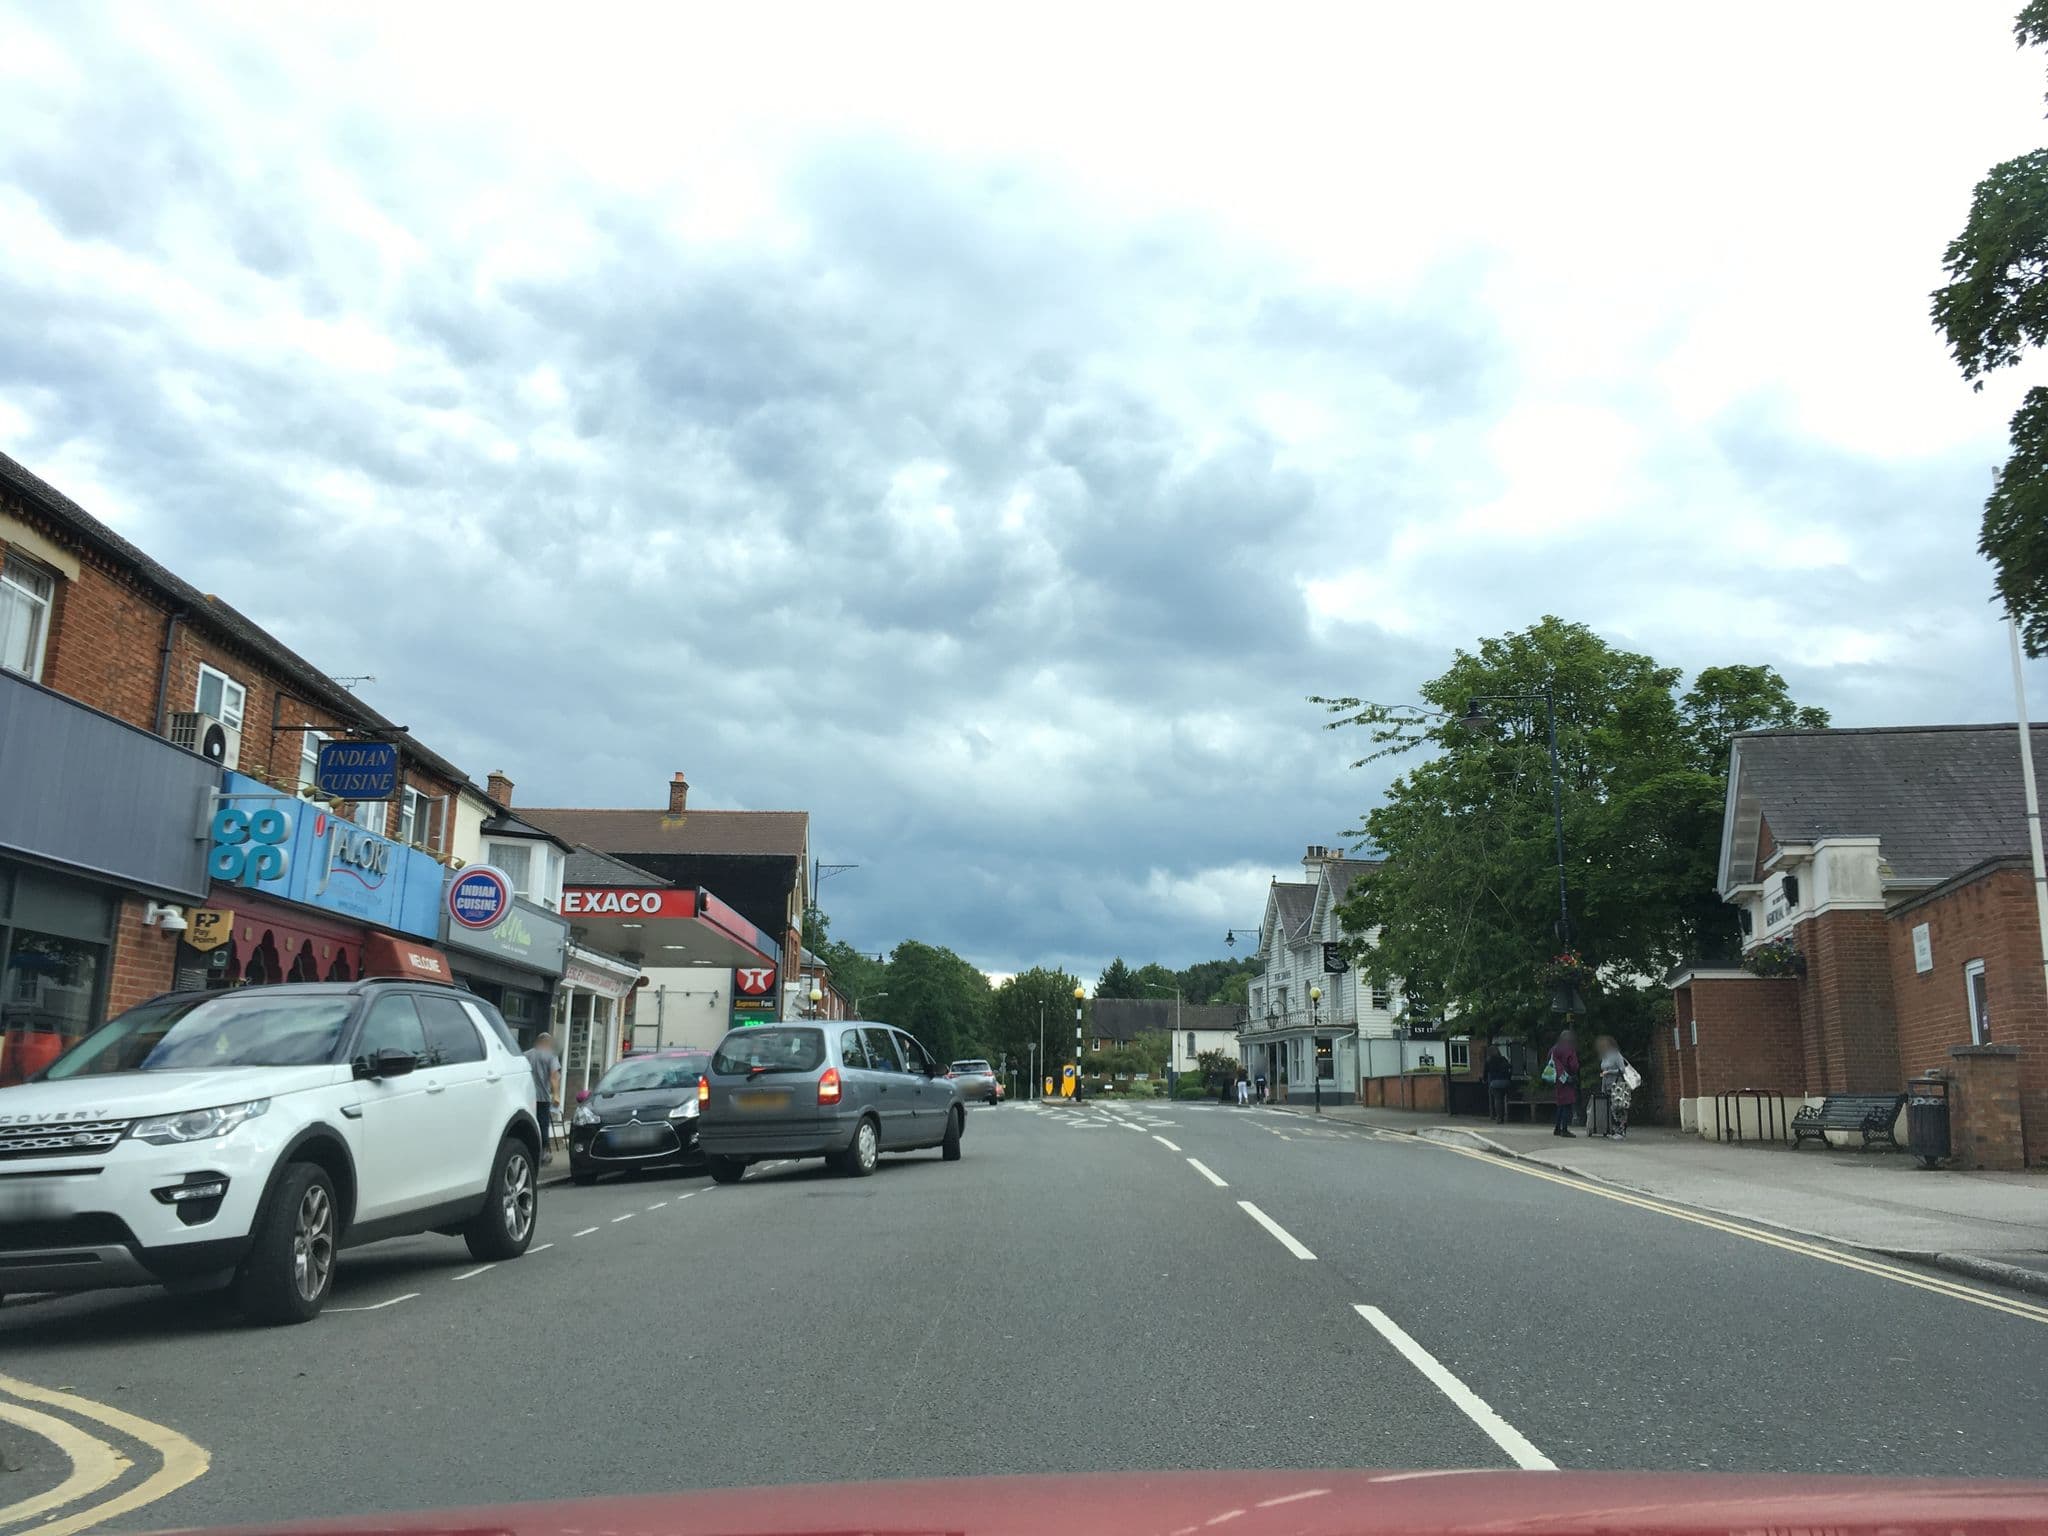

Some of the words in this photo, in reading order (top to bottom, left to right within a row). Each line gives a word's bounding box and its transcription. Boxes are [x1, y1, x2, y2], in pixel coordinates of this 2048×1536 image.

[327, 750, 391, 767] INDIAN
[320, 773, 394, 790] CUISINE
[461, 884, 497, 898] INDIAN
[456, 897, 497, 911] CUISINE
[562, 892, 662, 913] EXACO
[408, 952, 441, 973] WELCOME
